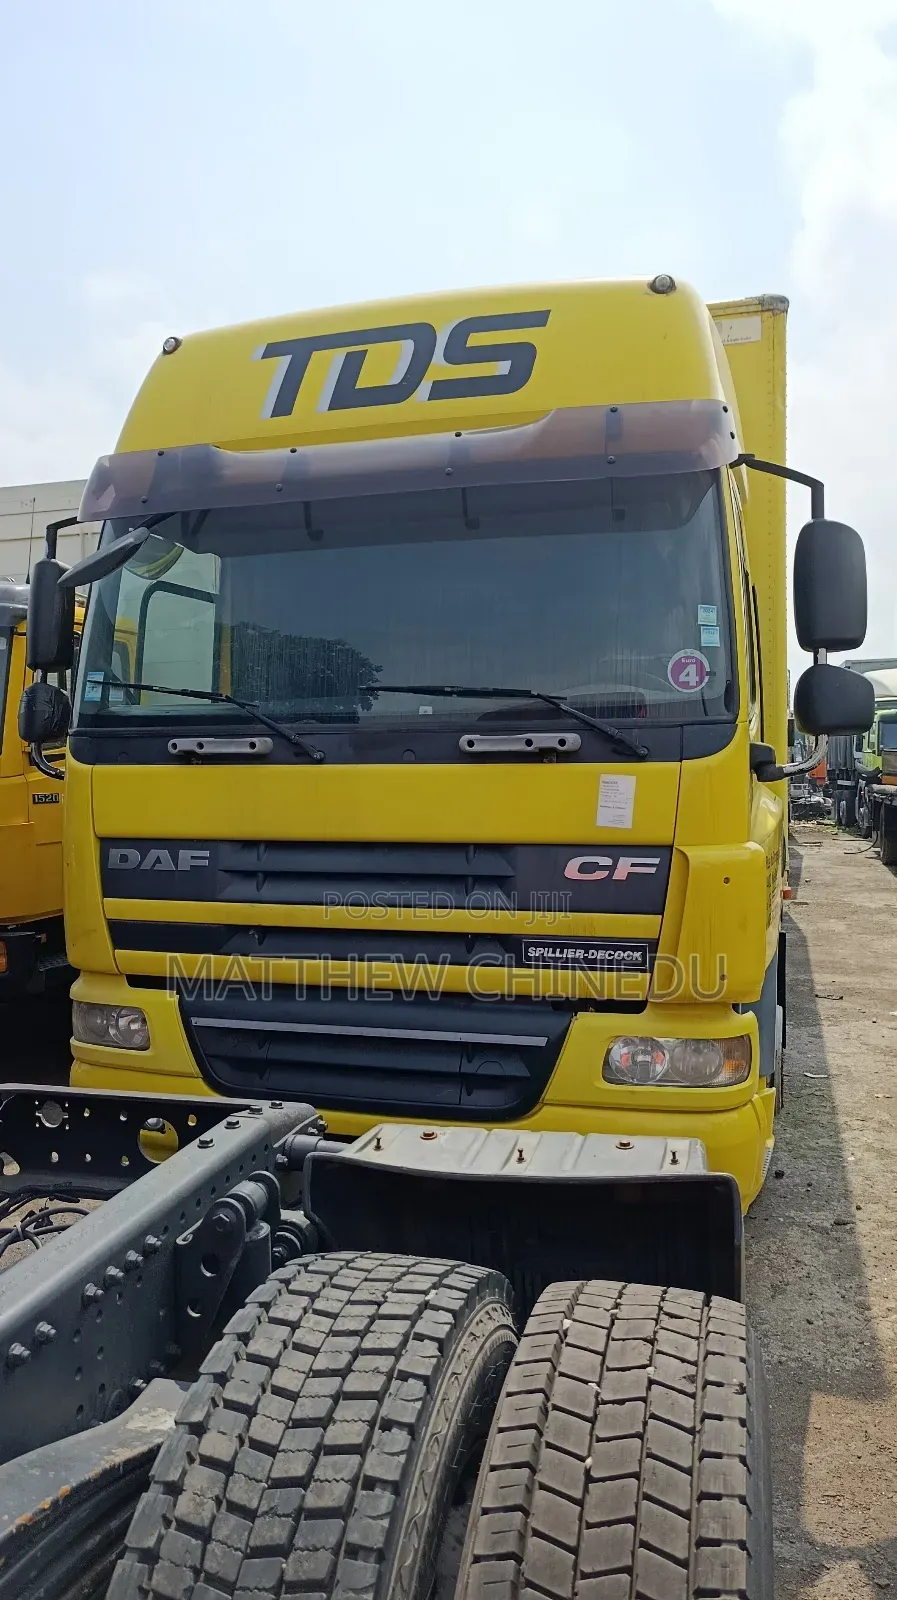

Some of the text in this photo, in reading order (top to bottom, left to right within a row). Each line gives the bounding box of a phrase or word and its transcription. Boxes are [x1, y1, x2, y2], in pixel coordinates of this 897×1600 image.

[252, 309, 551, 419] TDS
[679, 664, 699, 686] 4
[34, 794, 59, 803] 1520
[107, 848, 210, 871] DAF
[563, 855, 661, 881] CF
[527, 946, 643, 961] SPILLIER-DECOCK
